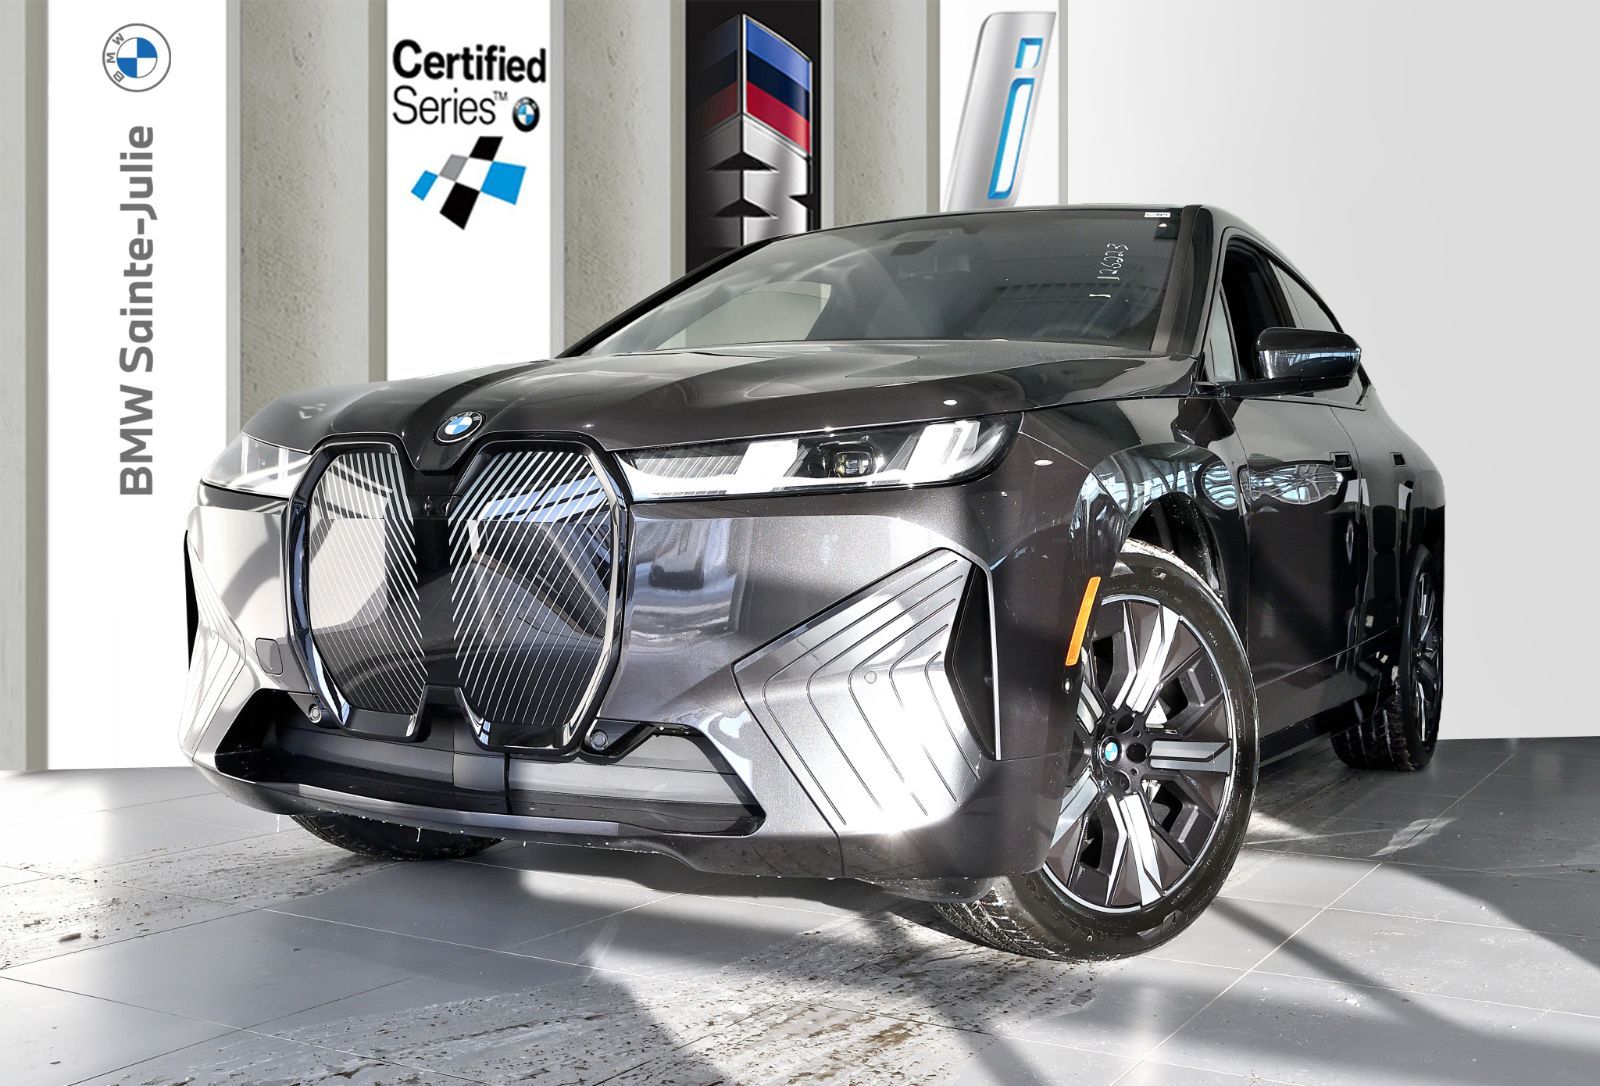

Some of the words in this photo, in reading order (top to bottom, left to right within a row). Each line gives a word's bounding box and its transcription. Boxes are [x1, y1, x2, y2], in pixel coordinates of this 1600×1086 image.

[106, 32, 125, 83] BMW
[393, 39, 547, 83] Certified
[119, 125, 158, 372] Sainte-Julie
[119, 384, 153, 495] BMW
